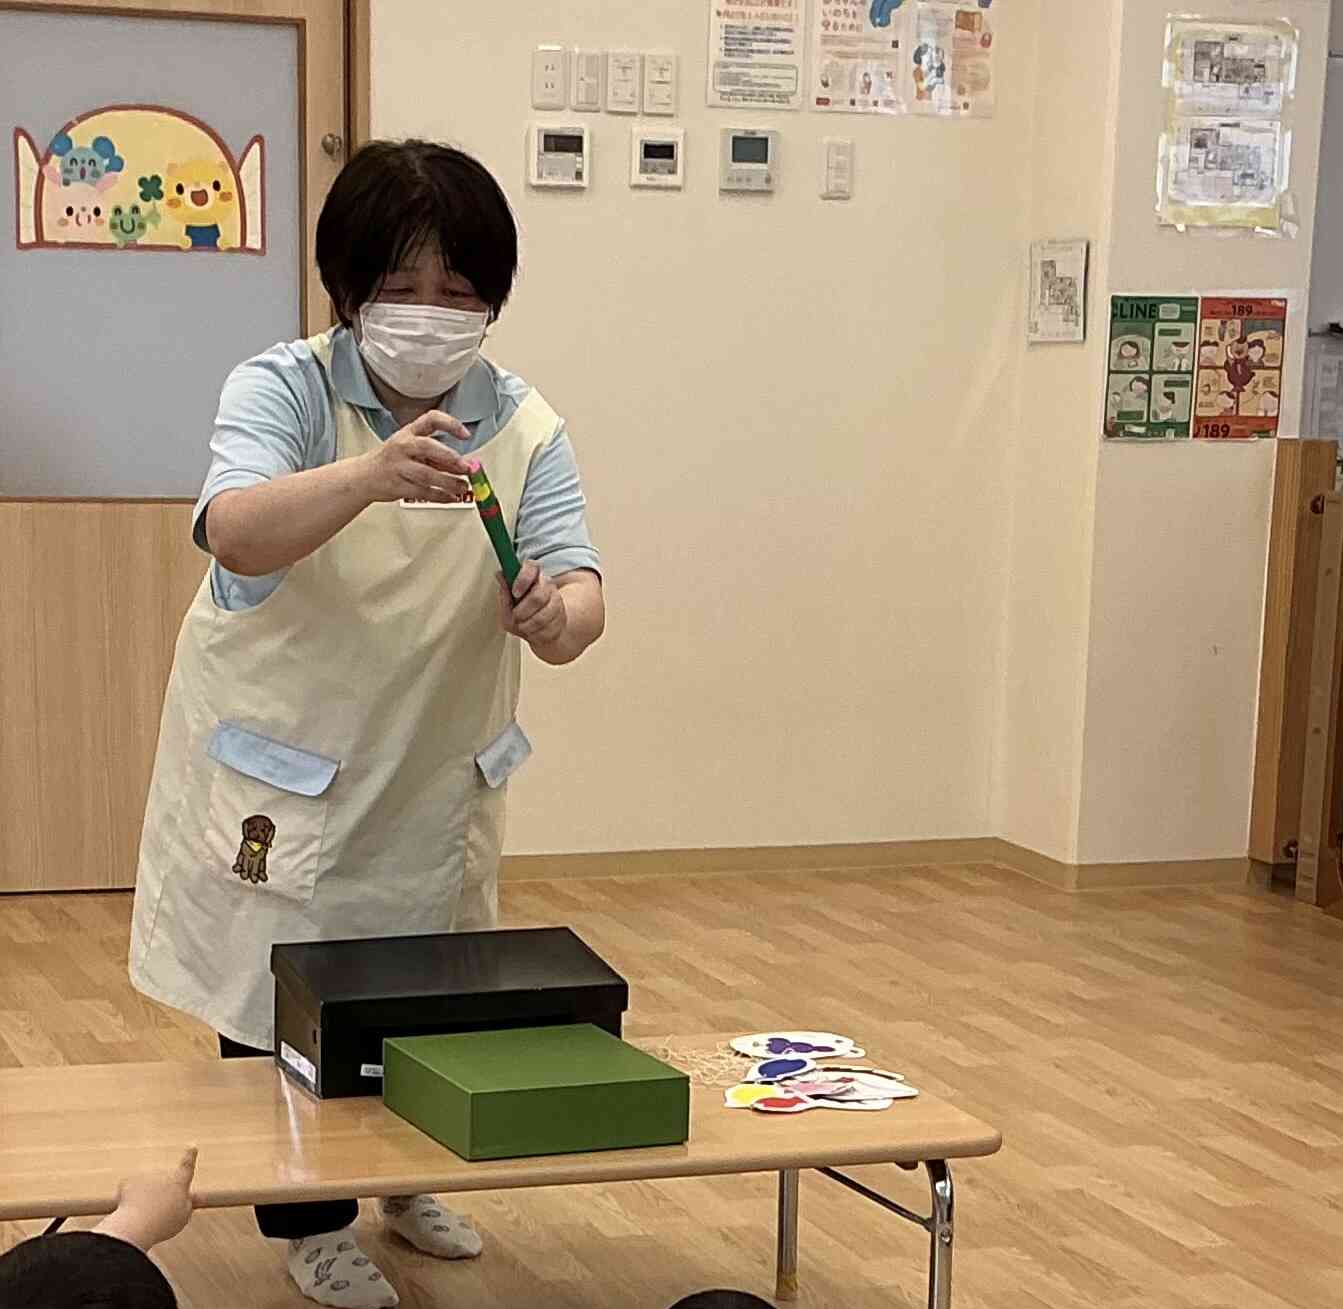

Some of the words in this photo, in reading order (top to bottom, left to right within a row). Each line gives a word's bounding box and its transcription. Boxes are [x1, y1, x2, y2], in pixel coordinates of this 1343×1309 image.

[1120, 302, 1157, 320] LINE
[1232, 304, 1253, 316] 189
[1204, 424, 1231, 438] 189
